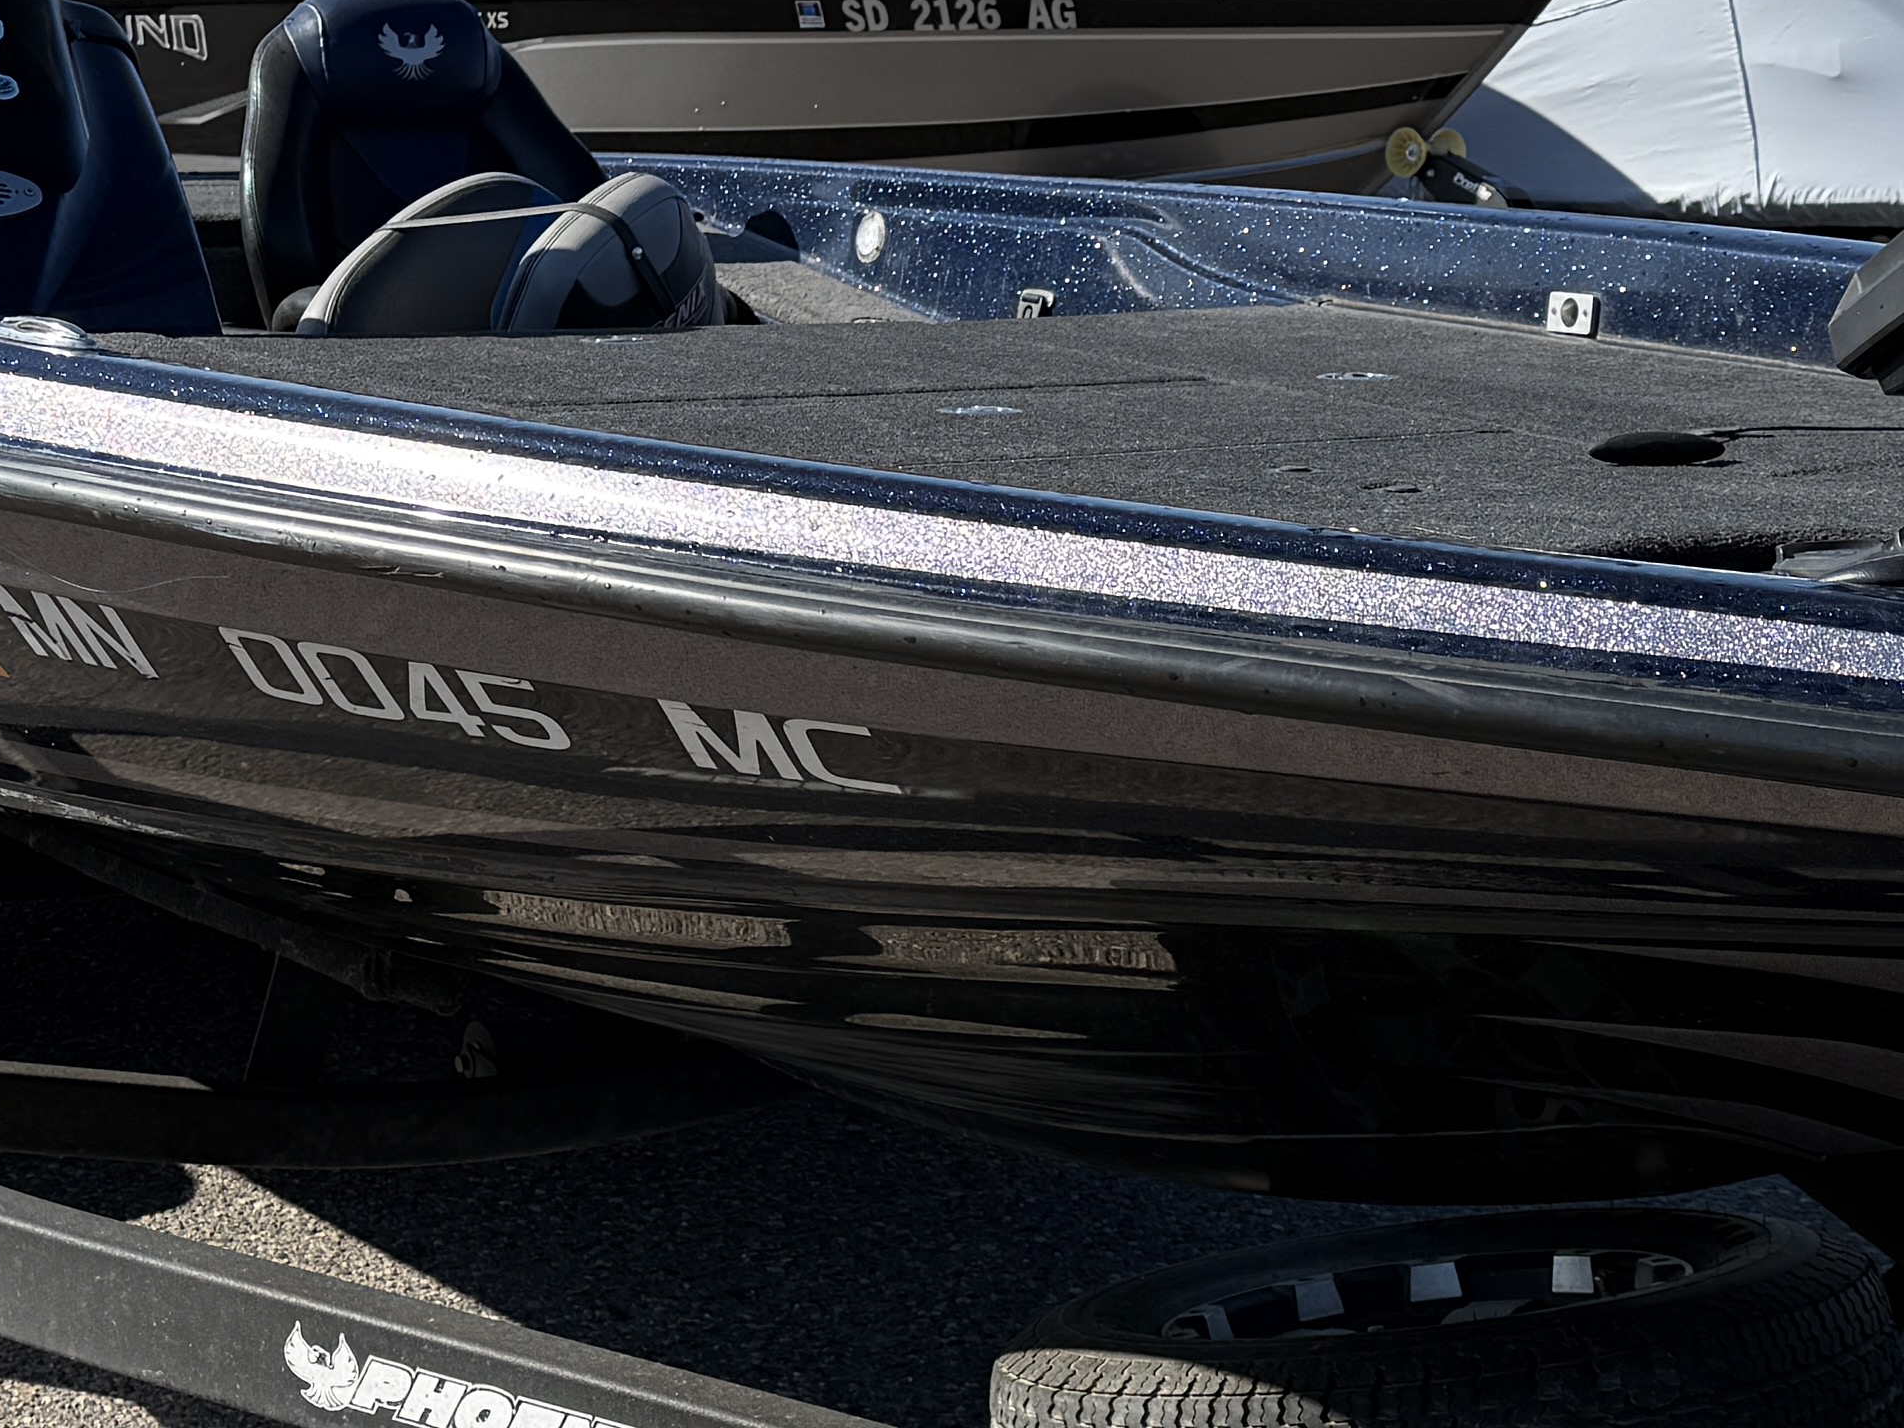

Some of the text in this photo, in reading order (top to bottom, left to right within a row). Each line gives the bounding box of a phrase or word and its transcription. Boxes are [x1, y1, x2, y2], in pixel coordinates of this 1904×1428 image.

[842, 0, 889, 32] SD
[219, 626, 571, 750] 0045
[657, 697, 902, 795] MC
